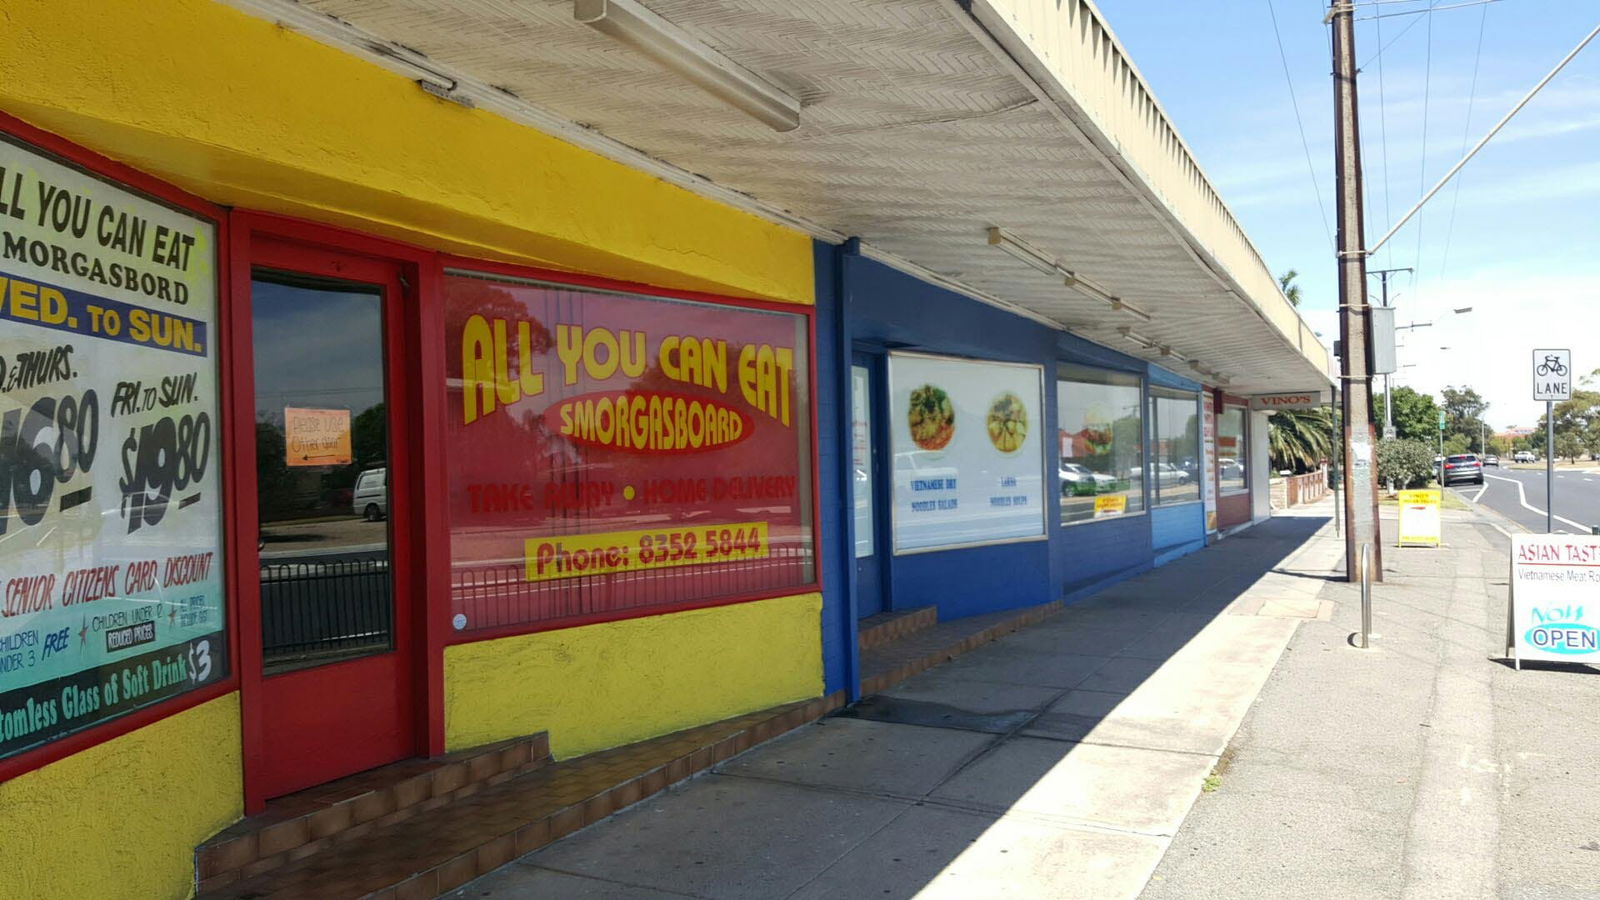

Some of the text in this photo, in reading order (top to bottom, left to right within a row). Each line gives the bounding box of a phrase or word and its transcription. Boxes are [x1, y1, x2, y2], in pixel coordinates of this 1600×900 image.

[38, 181, 91, 239] YOU
[97, 205, 147, 258] CAN
[152, 225, 195, 271] EAT
[87, 305, 121, 336] TO
[129, 309, 202, 353] SUN.
[462, 314, 793, 428] ALL YOU CAN EAT
[111, 372, 199, 417] FRI. TO SUN.
[1261, 395, 1312, 406] VINO'S
[1536, 382, 1568, 394] LANE
[560, 395, 743, 450] SMORGASBOARD
[467, 482, 616, 514] TAKE AWAY
[644, 475, 796, 505] HOME DELIVERY
[536, 526, 761, 575] Phone: 8352 5844
[1518, 544, 1600, 562] ASIAN TAST
[2, 552, 213, 618] SENIOR CITIZENS CARD DISCOUNT
[1519, 568, 1564, 582] Vietnamese
[1566, 569, 1587, 582] Meat
[92, 610, 128, 632] CHILDREN
[131, 605, 153, 622] UNDER
[0, 630, 38, 652] HILDREN
[41, 627, 70, 661] FREE
[108, 623, 154, 650] REDUCED PRICES
[1533, 629, 1596, 649] OPEN
[28, 650, 36, 667] 3
[62, 685, 100, 720] Glass
[104, 673, 119, 706] of
[123, 665, 149, 700] Soft
[152, 653, 187, 690] Drink
[188, 639, 212, 685] $3
